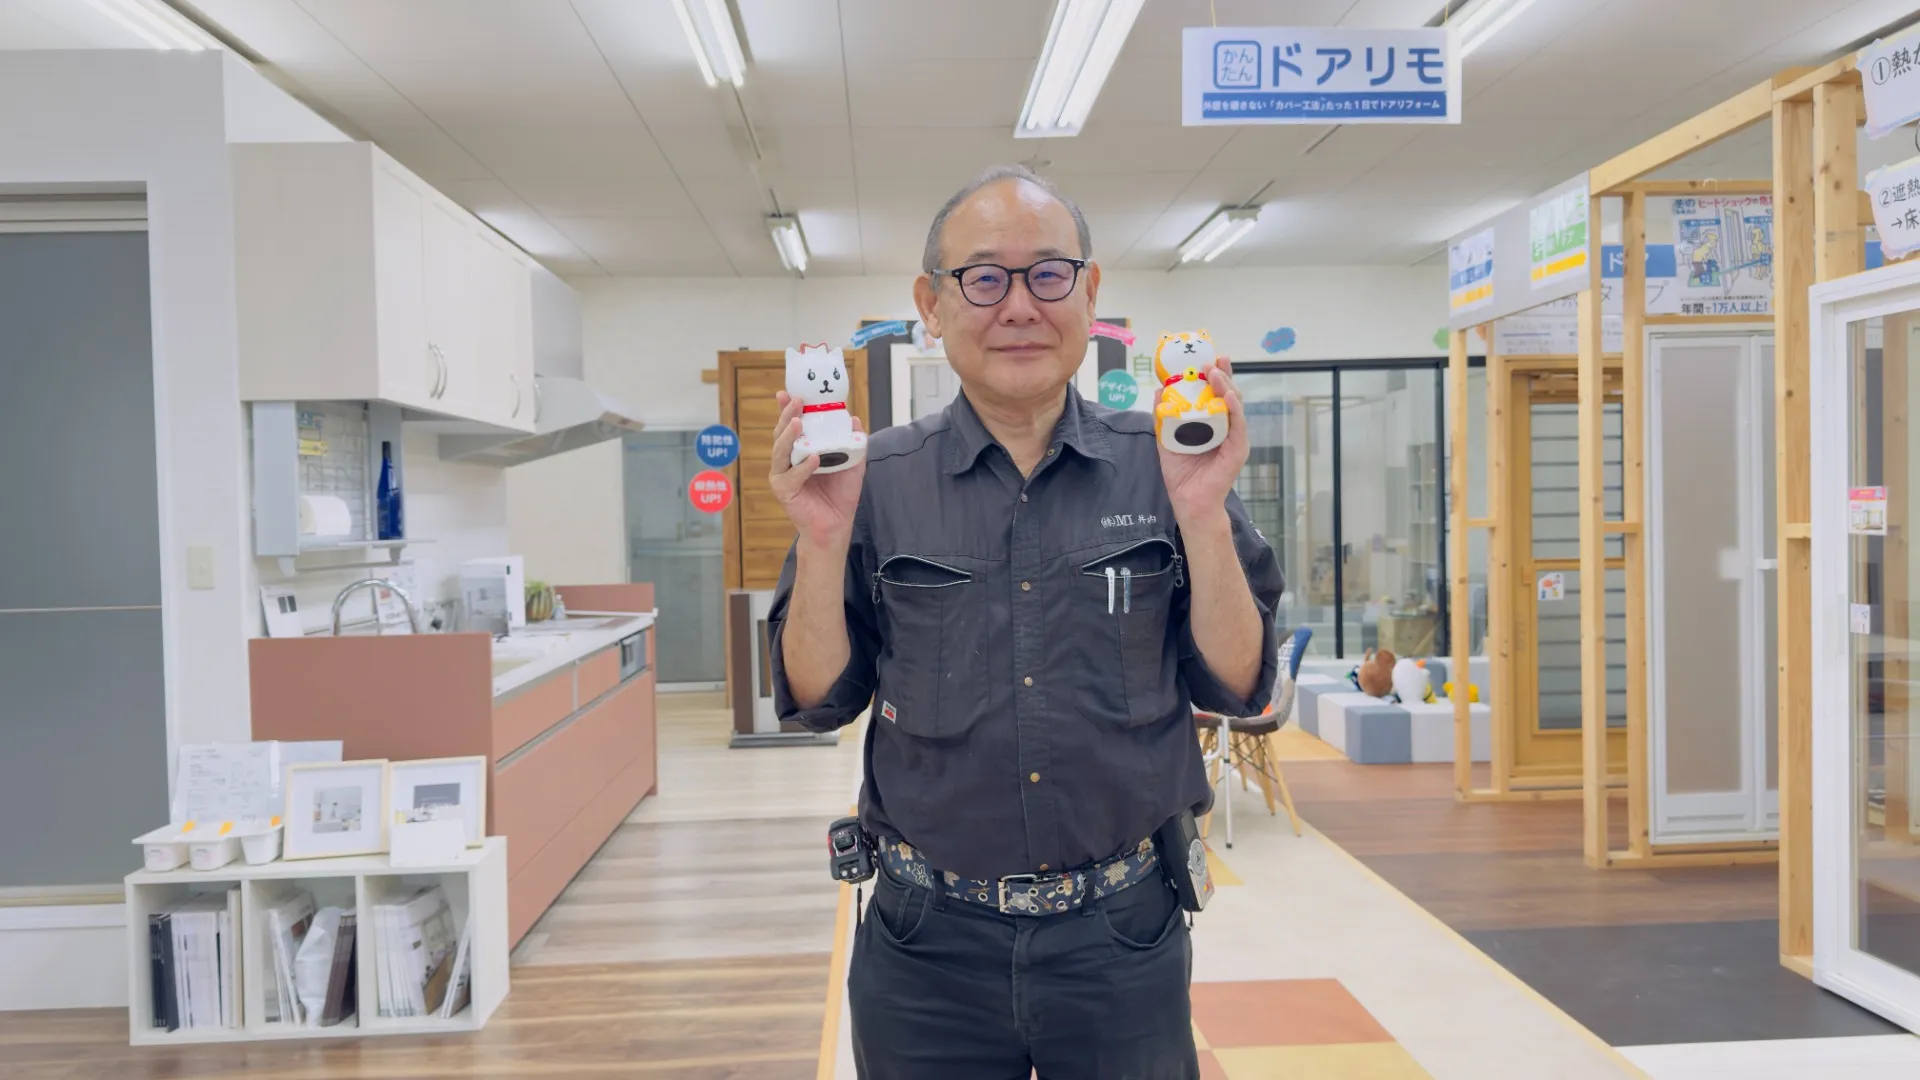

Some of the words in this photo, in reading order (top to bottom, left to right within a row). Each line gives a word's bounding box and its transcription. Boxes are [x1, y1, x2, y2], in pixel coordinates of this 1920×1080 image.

[1223, 48, 1254, 65] かん
[1273, 43, 1444, 88] ドアリモ
[1221, 66, 1253, 82] たん
[707, 447, 728, 458] UP!
